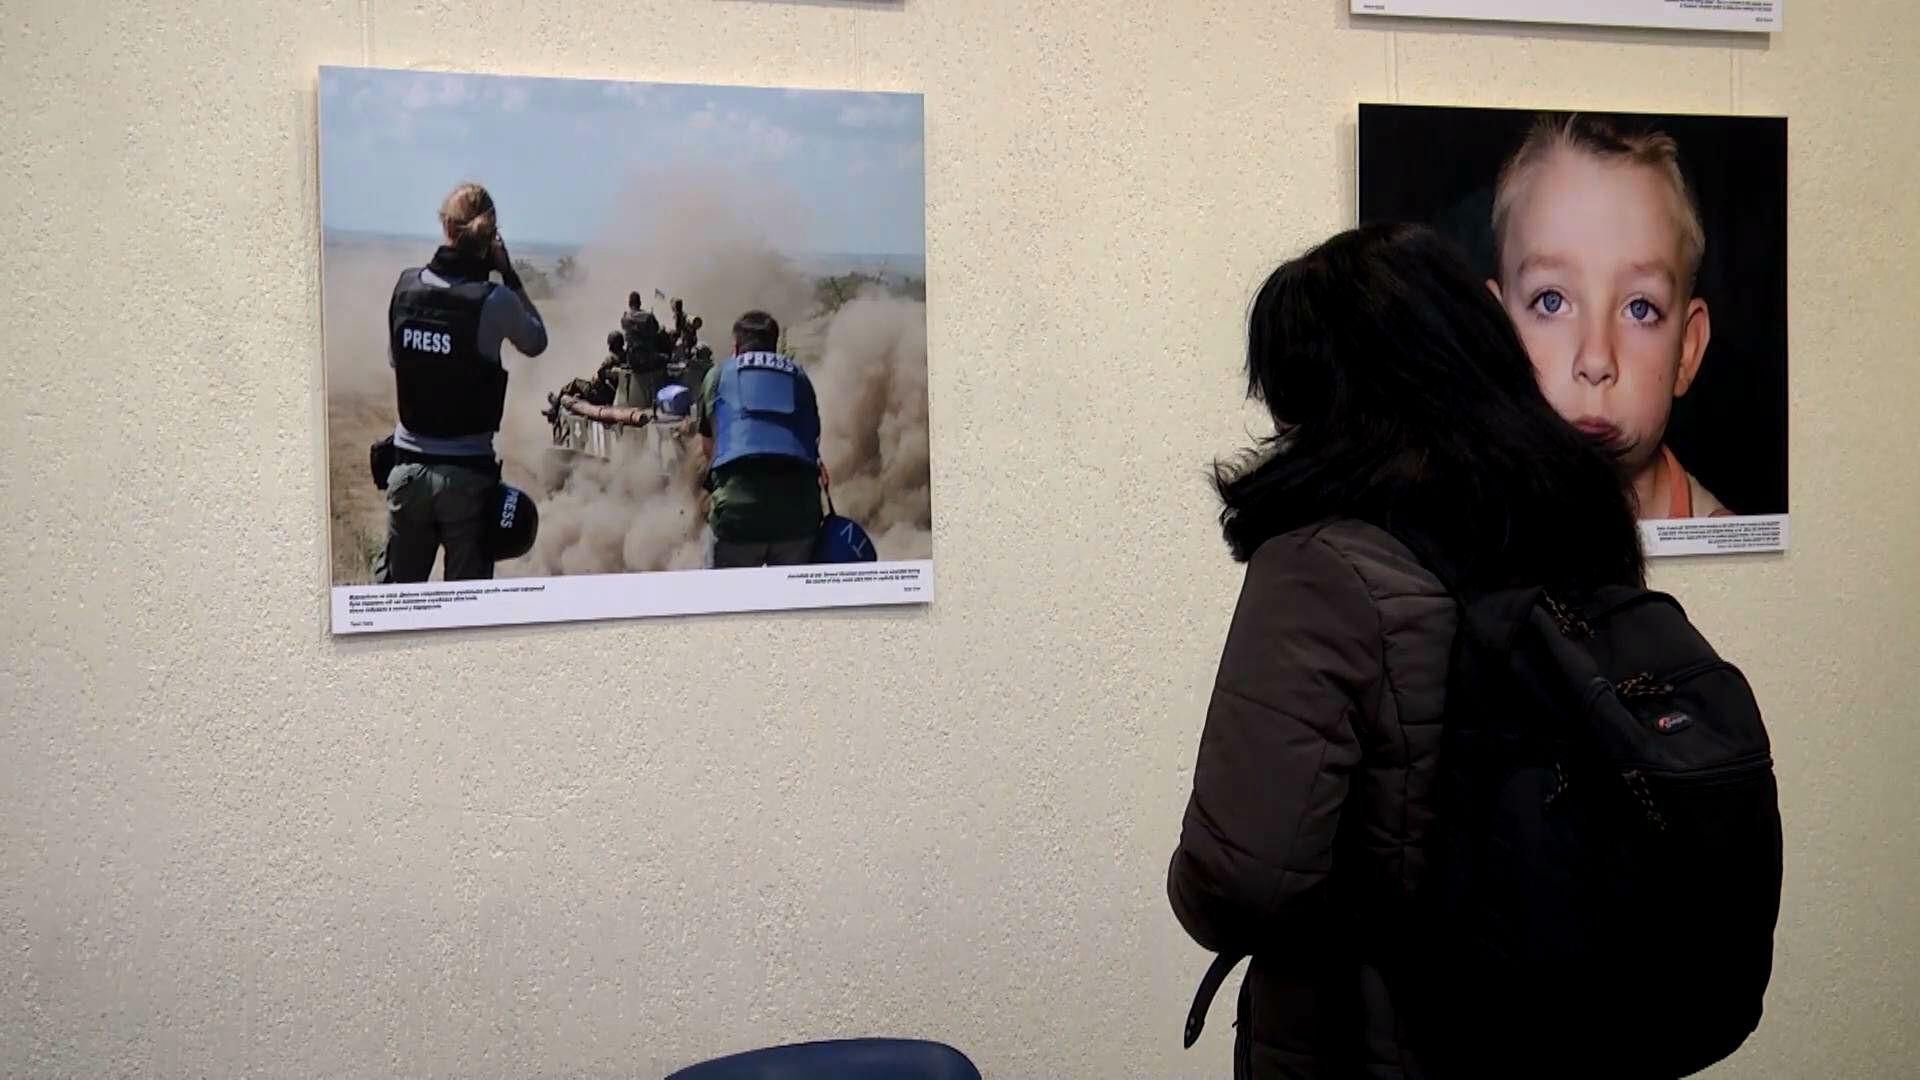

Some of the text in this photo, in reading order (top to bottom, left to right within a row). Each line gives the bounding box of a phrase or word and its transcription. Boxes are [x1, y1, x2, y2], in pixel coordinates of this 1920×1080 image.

[403, 328, 452, 355] PRESS
[744, 351, 794, 372] PRESS
[500, 488, 520, 529] PRESS
